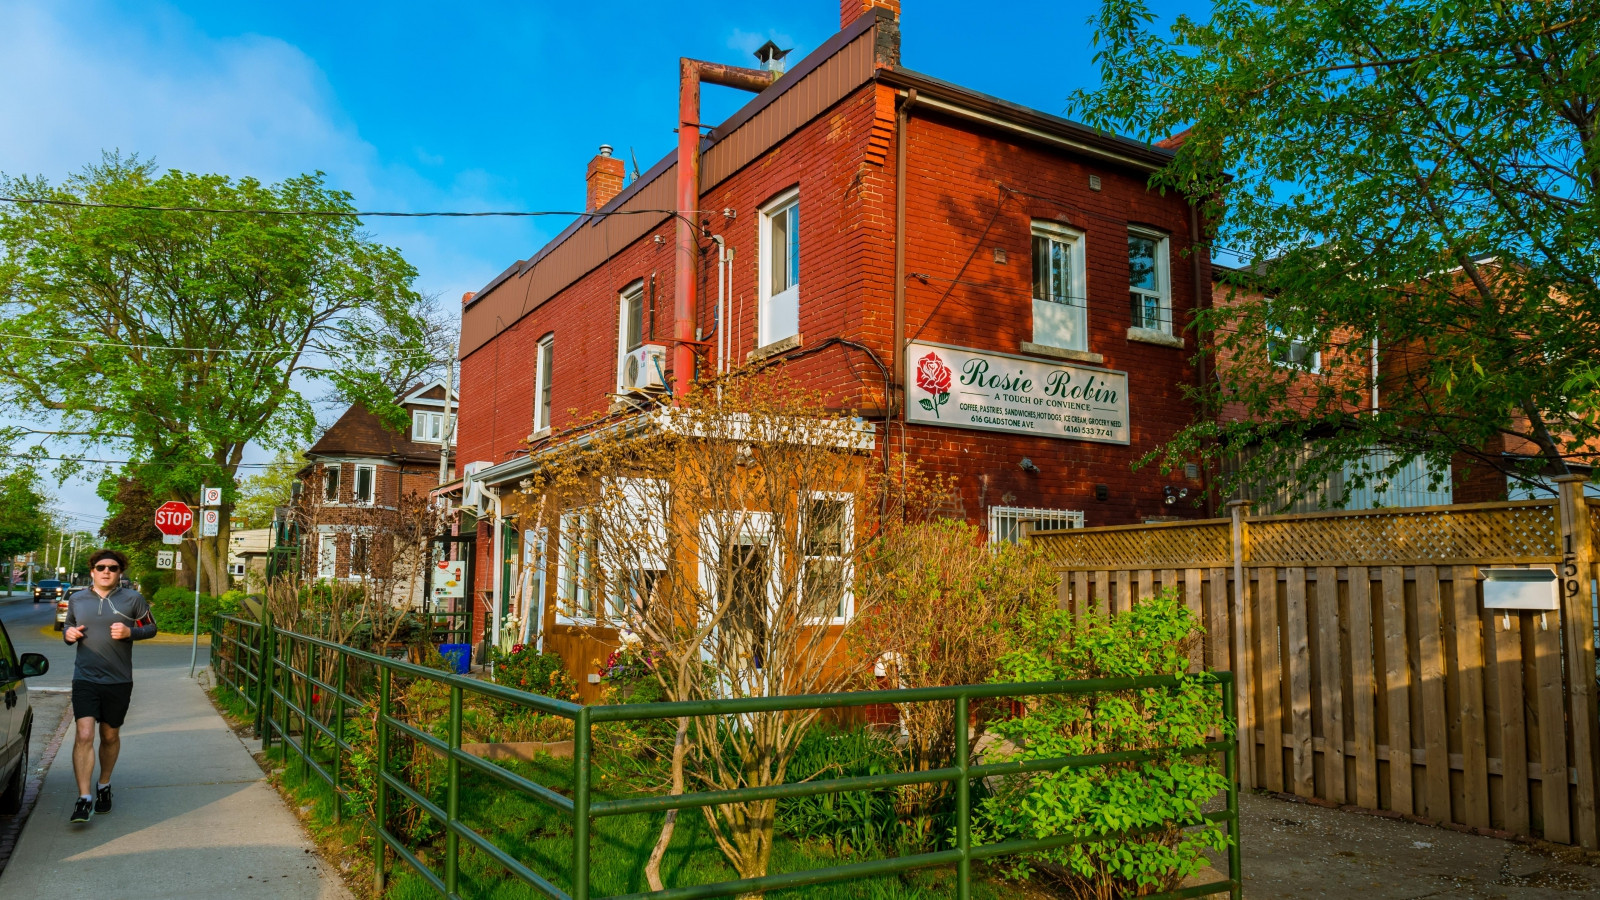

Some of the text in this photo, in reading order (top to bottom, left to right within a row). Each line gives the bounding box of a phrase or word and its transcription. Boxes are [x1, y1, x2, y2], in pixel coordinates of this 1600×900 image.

[960, 357, 1118, 404] Rosie Robin
[994, 393, 1091, 411] A TOUCH OF CONVIENCE
[959, 402, 980, 413] COFFEE,
[980, 405, 1004, 416] PASTRIES,
[1088, 417, 1110, 427] GROCERY
[970, 415, 983, 423] 616
[983, 416, 1020, 427] GLADSTONE
[1063, 425, 1081, 434] (416)
[157, 511, 192, 526] STOP
[158, 558, 171, 566] 30
[1564, 534, 1580, 598] 159
